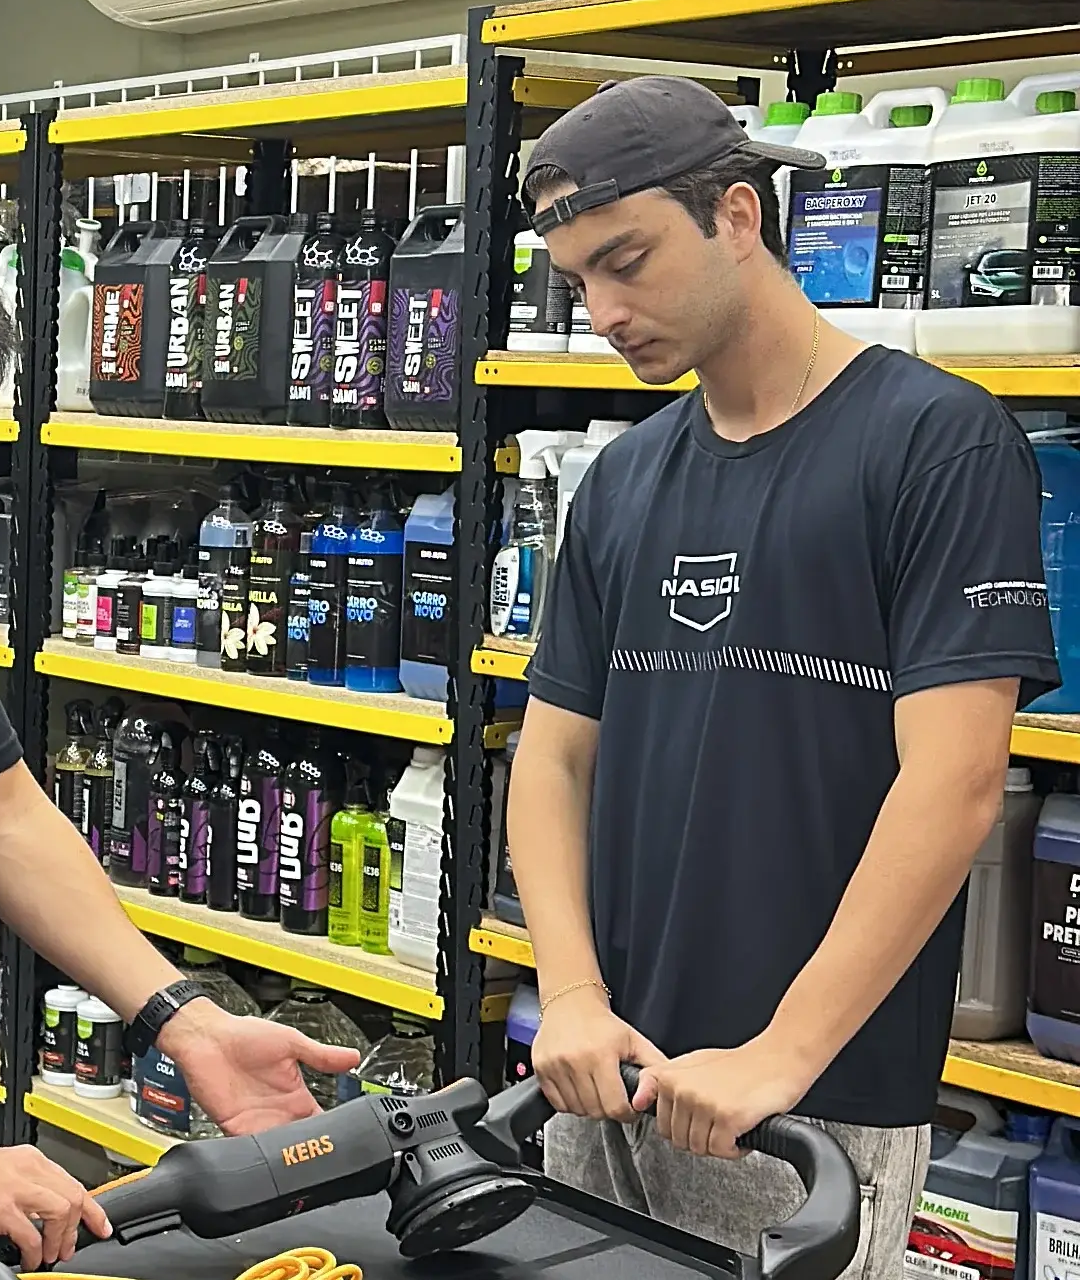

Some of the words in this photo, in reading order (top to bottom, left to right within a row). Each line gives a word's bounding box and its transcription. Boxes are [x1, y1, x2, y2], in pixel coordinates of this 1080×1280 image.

[805, 197, 825, 210] BAC
[826, 195, 866, 208] PEROXY
[965, 195, 981, 208] JET
[984, 193, 997, 204] 20
[102, 291, 120, 358] PRIME
[167, 278, 189, 368] URBAN
[215, 284, 235, 357] URBAN
[291, 285, 316, 380] SWEET
[334, 285, 362, 383] SWEET
[405, 297, 427, 376] SWEET
[500, 566, 509, 602] CLEAR
[661, 575, 740, 597] NASIOL
[413, 591, 447, 607] CARRO
[414, 605, 443, 620] NOVO
[156, 1061, 175, 1077] COLA
[281, 1135, 335, 1166] KERS
[1049, 1237, 1080, 1260] BRILH
[960, 1270, 973, 1280] GEL
